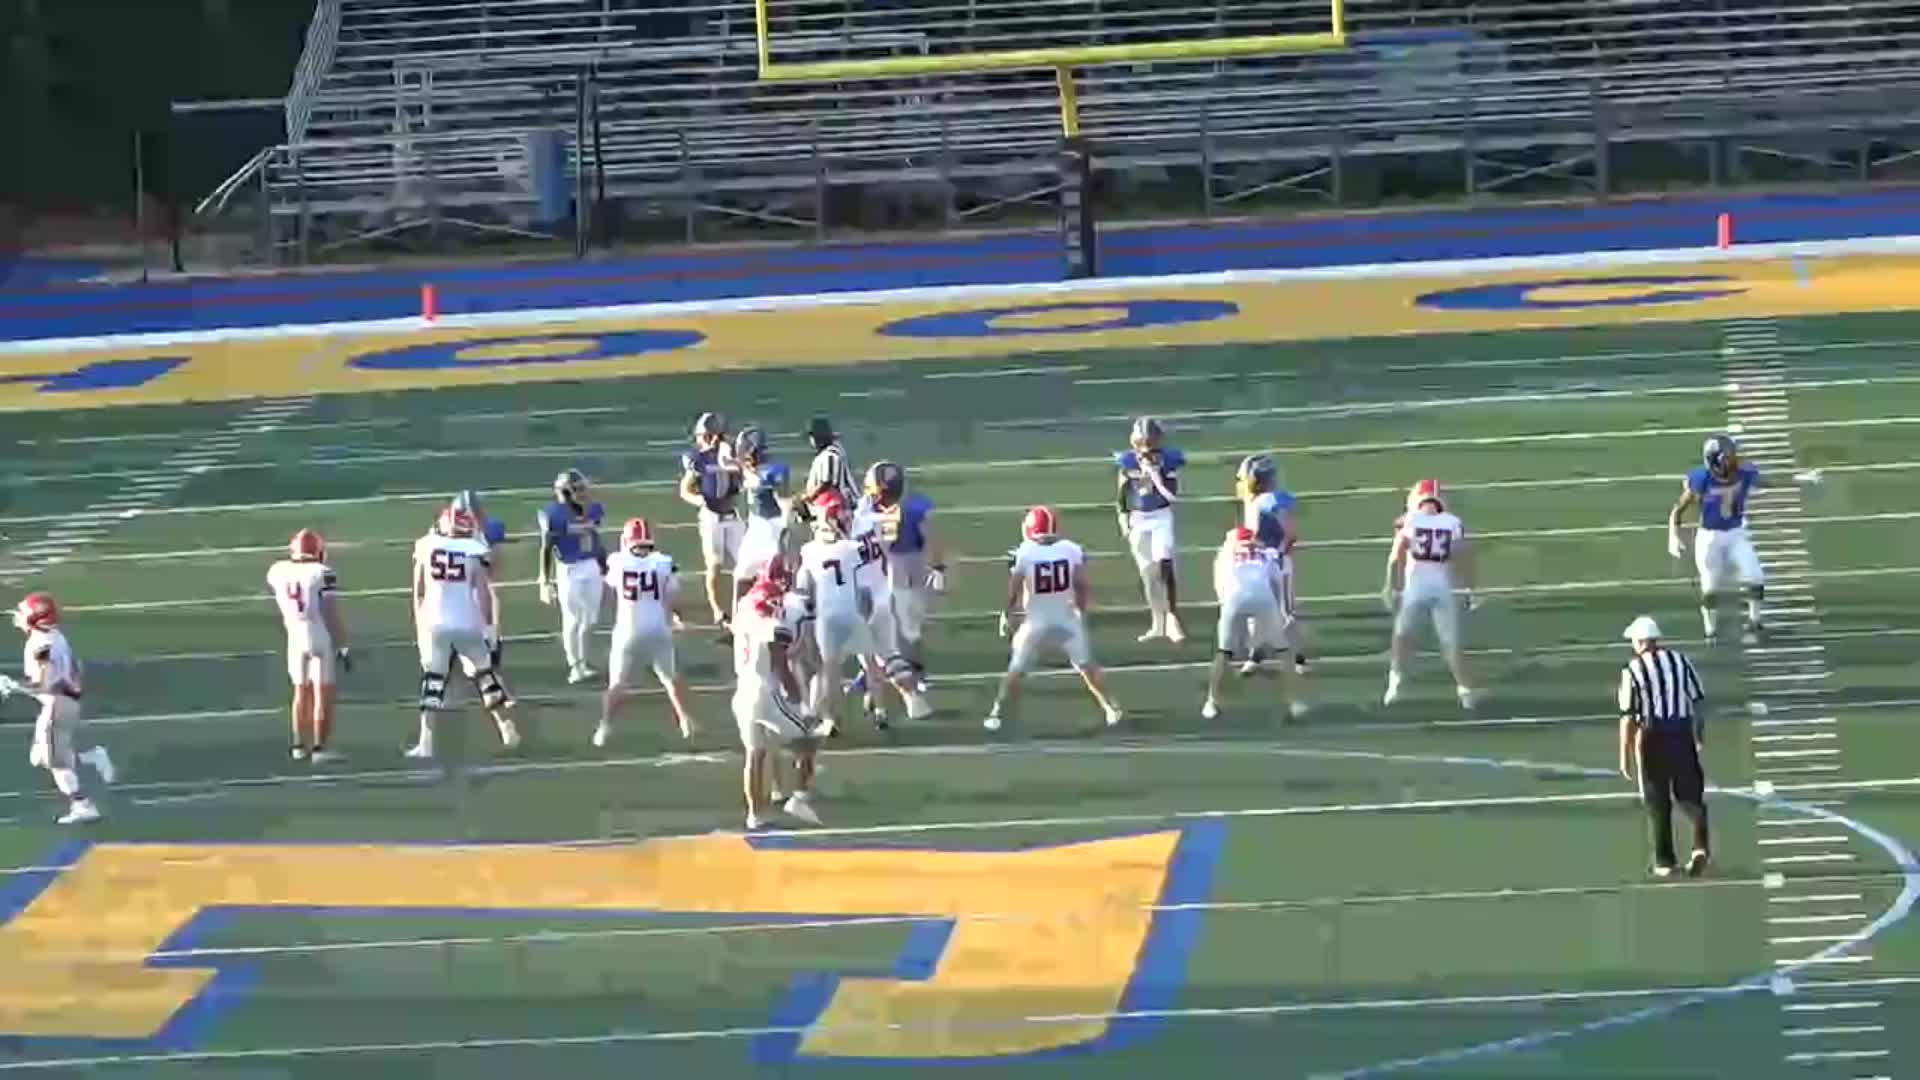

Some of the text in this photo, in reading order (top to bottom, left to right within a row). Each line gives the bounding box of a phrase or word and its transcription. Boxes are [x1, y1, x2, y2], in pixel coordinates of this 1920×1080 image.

[1412, 527, 1452, 562] 33
[430, 548, 466, 581] 55
[822, 558, 846, 587] 7
[1034, 559, 1070, 594] 60
[286, 581, 305, 612] 4
[622, 570, 660, 601] 54
